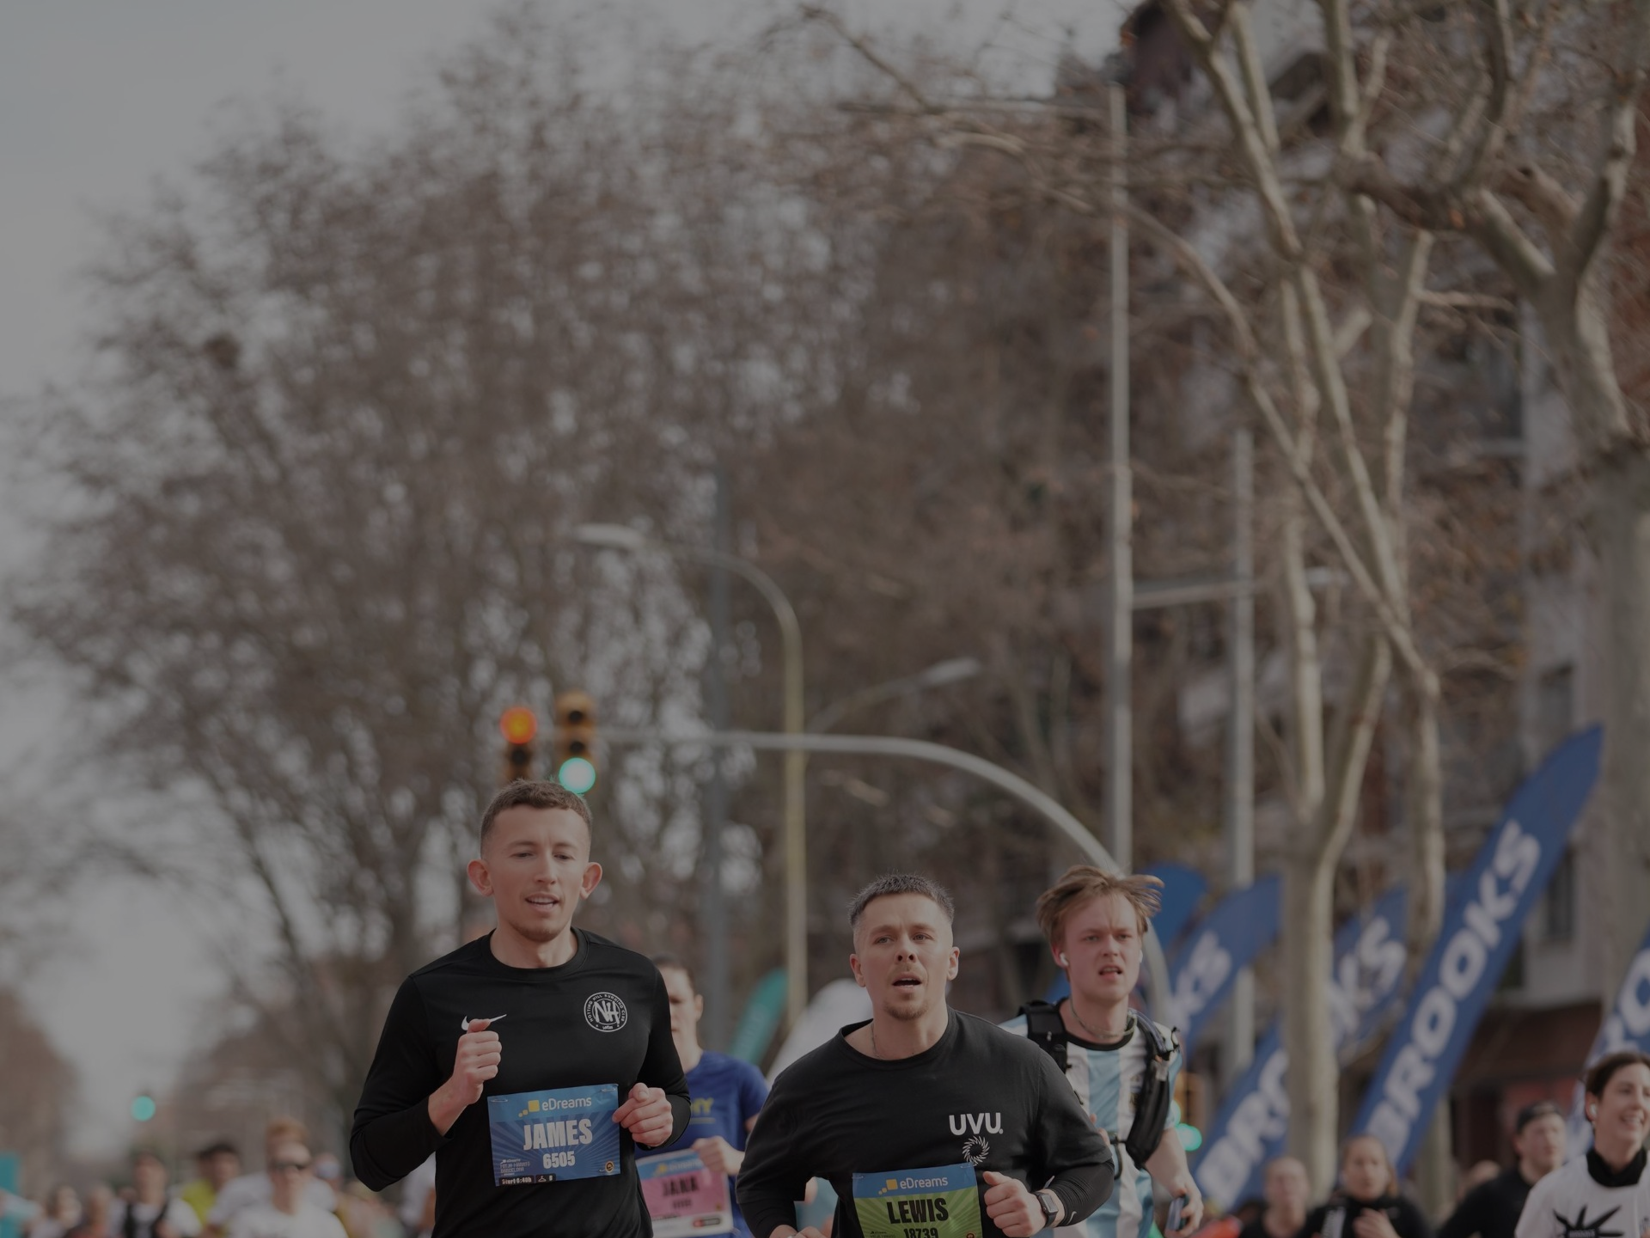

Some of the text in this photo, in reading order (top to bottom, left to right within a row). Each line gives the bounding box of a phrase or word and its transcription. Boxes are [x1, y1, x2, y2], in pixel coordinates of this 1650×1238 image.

[1365, 819, 1542, 1167] BROOKS
[541, 1097, 592, 1111] eDreams
[523, 1118, 593, 1151] JAMES
[542, 1151, 576, 1169] 6505
[661, 1176, 699, 1197] JANA
[899, 1176, 949, 1190] eDreams
[886, 1198, 949, 1224] LEWIS
